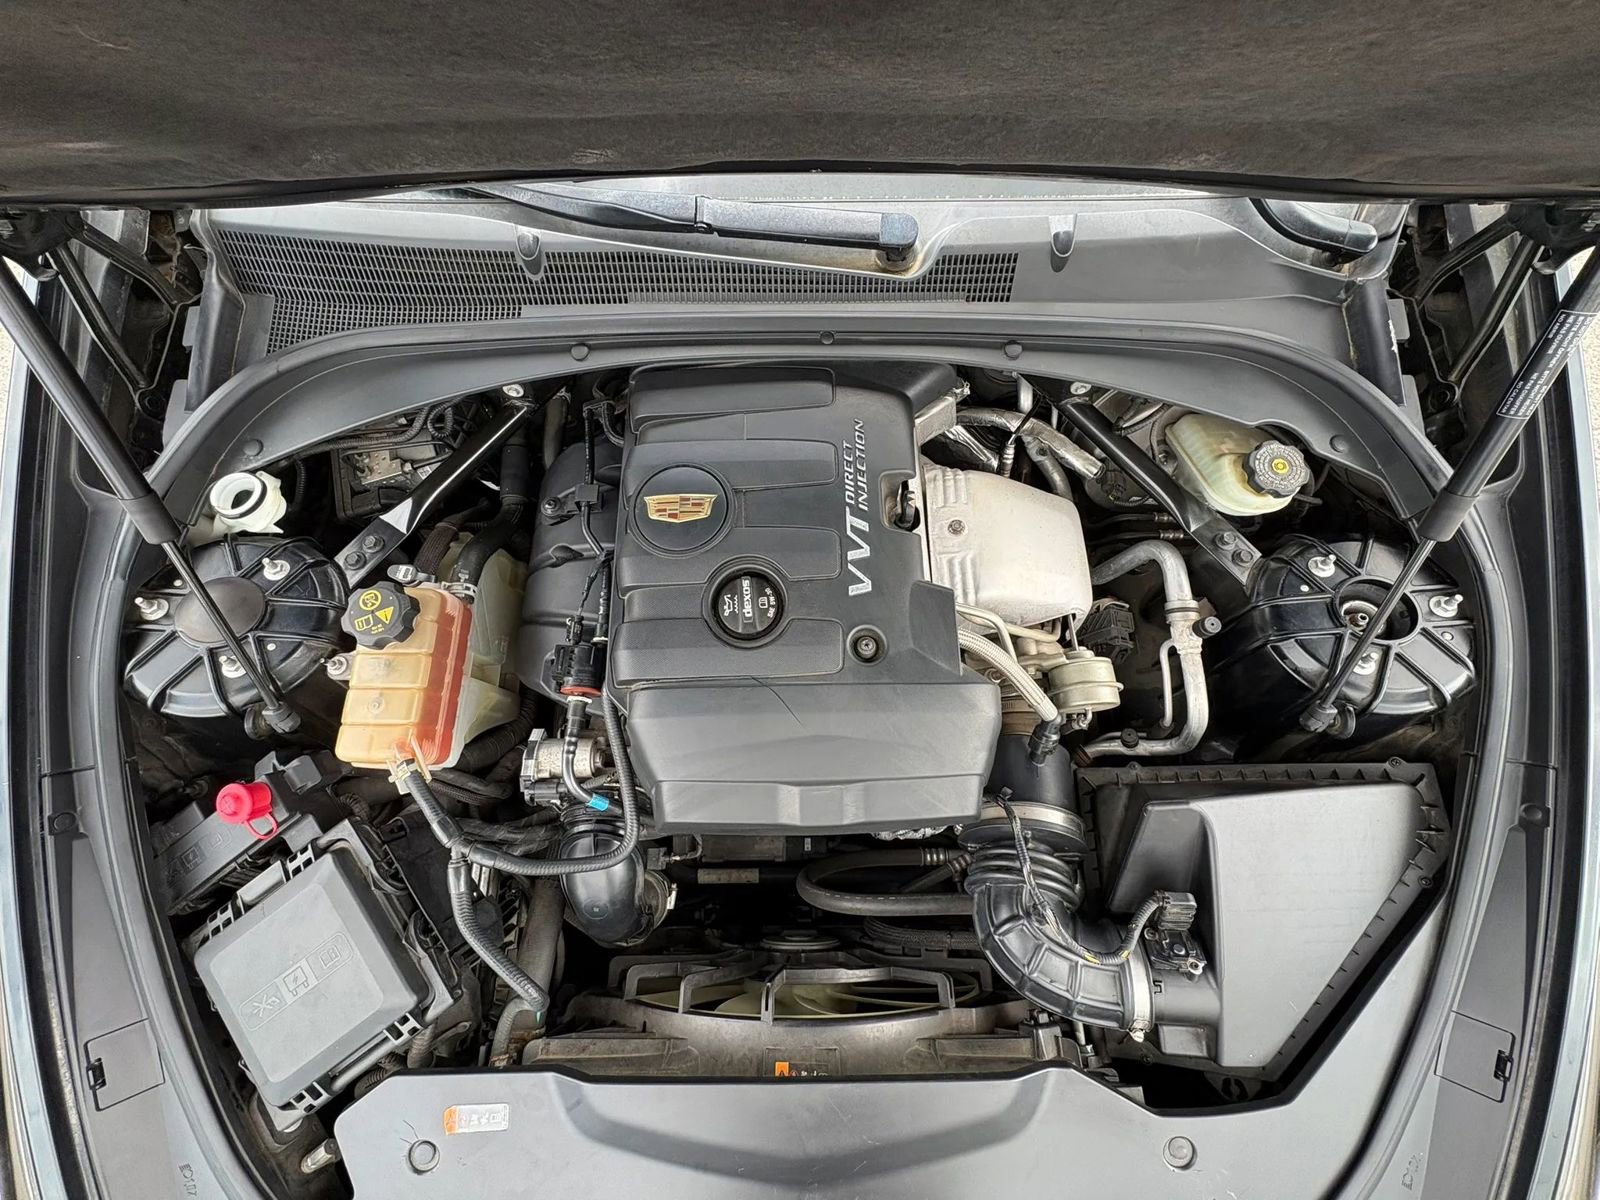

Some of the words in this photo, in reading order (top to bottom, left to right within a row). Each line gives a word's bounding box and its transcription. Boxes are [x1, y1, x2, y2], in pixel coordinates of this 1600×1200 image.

[1547, 322, 1560, 338] ABRIR
[1559, 323, 1570, 333] PAS
[1570, 316, 1585, 330] BITTE
[1546, 334, 1564, 354] OUVRIR
[1560, 331, 1575, 347] NICHT
[1523, 380, 1534, 389] PAS
[1500, 388, 1519, 412] CALENTAR
[1508, 389, 1528, 414] CHAUFFER
[842, 440, 855, 505] DIRECT
[854, 418, 869, 511] INJECTION
[845, 505, 872, 597] VVT
[742, 579, 753, 617] dexos
[767, 607, 776, 618] SAE
